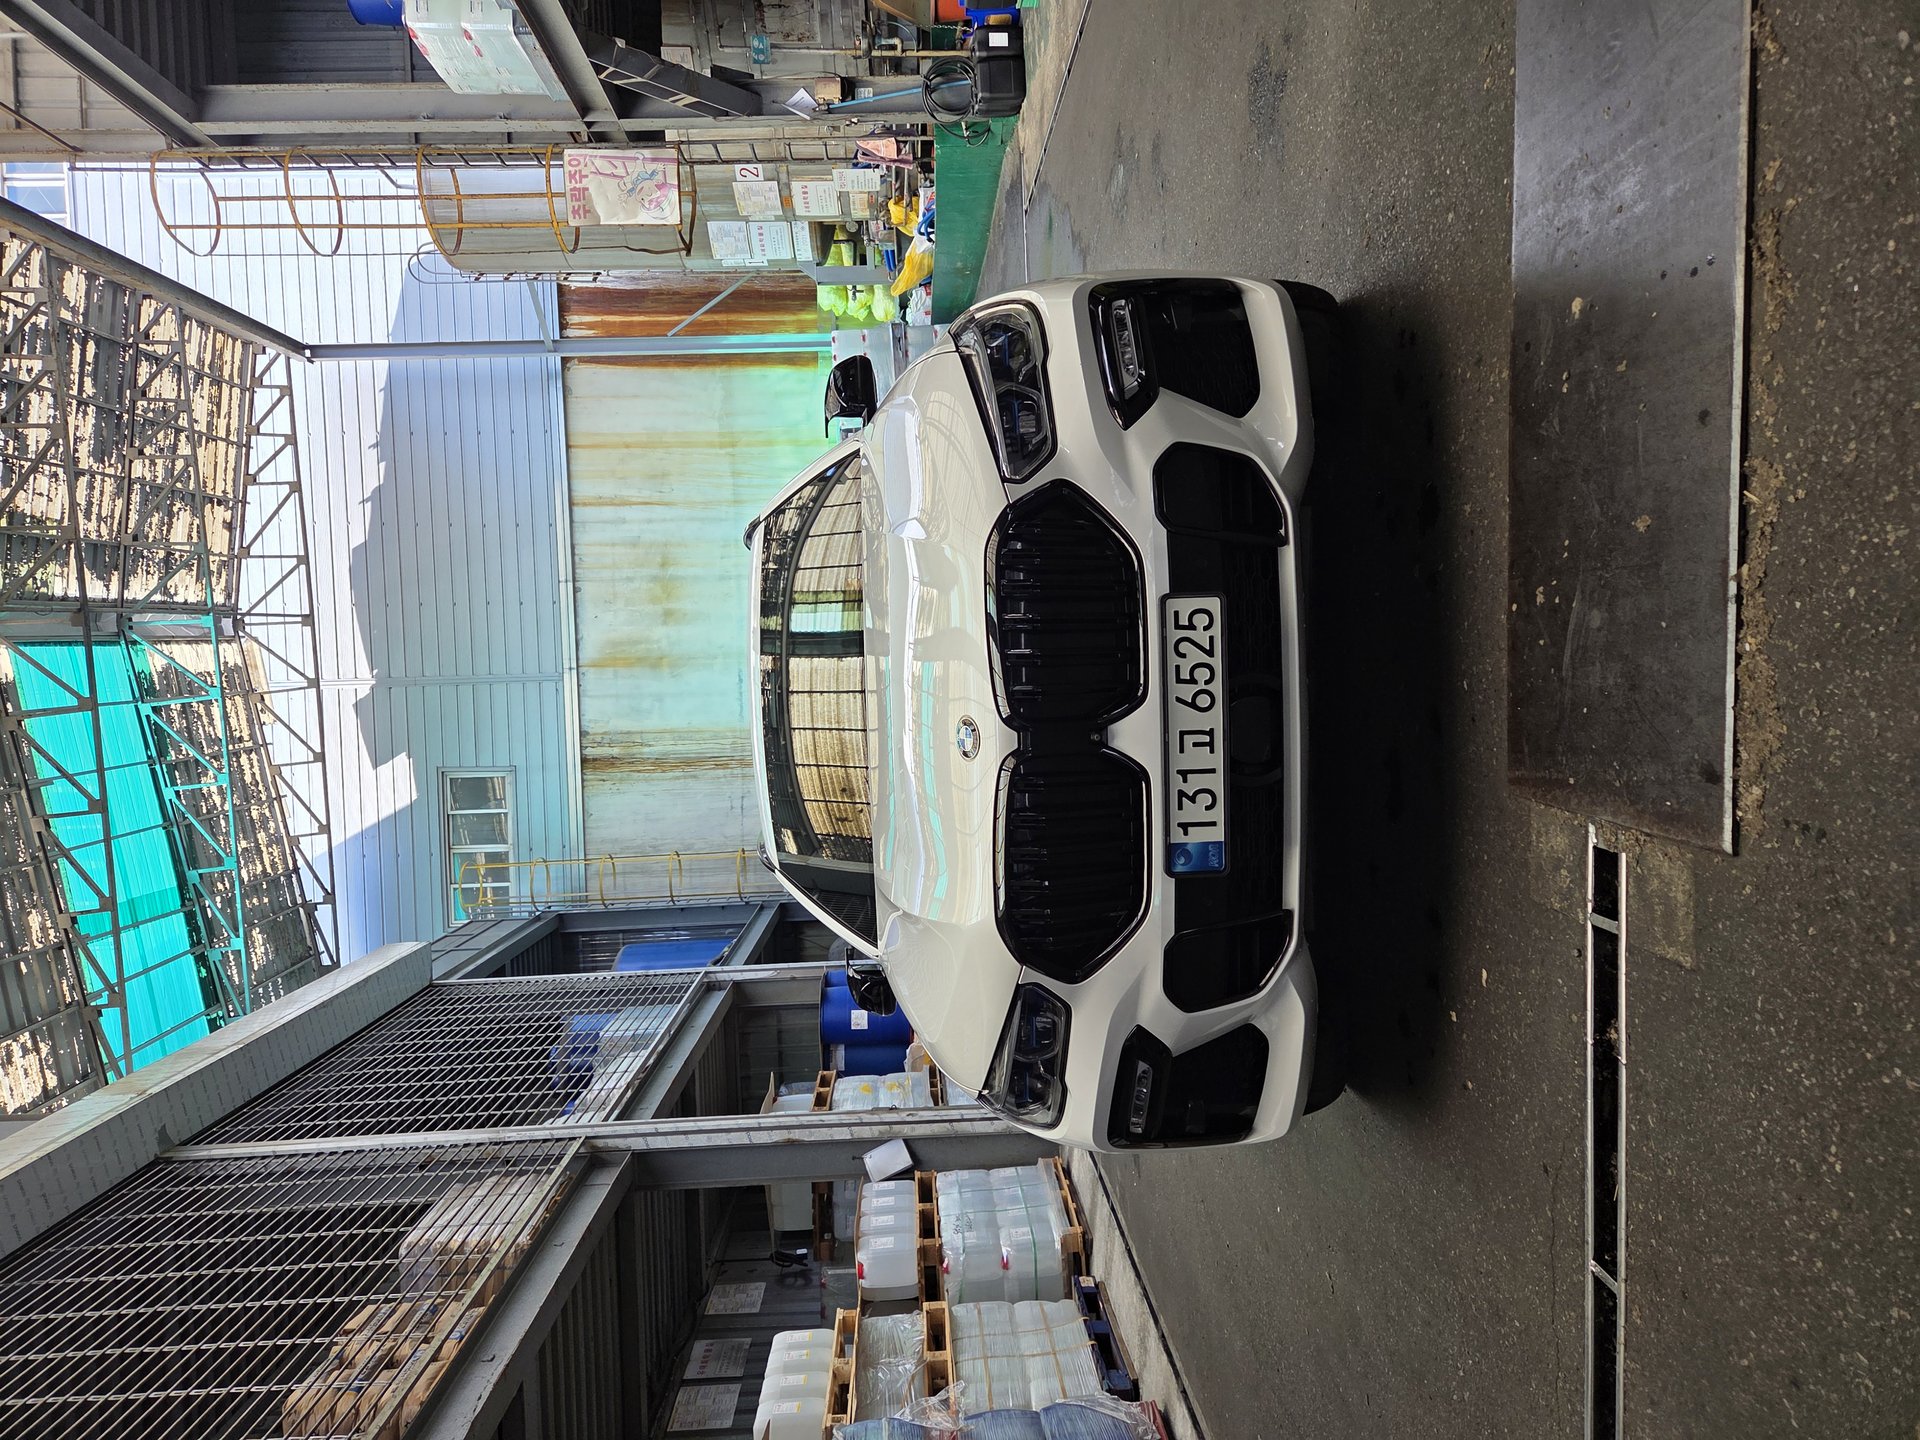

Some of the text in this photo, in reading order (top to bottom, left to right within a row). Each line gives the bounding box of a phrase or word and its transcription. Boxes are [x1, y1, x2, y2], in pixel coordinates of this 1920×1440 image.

[567, 154, 591, 220] 추락주의
[739, 167, 759, 178] 2
[1173, 608, 1215, 713] 6525
